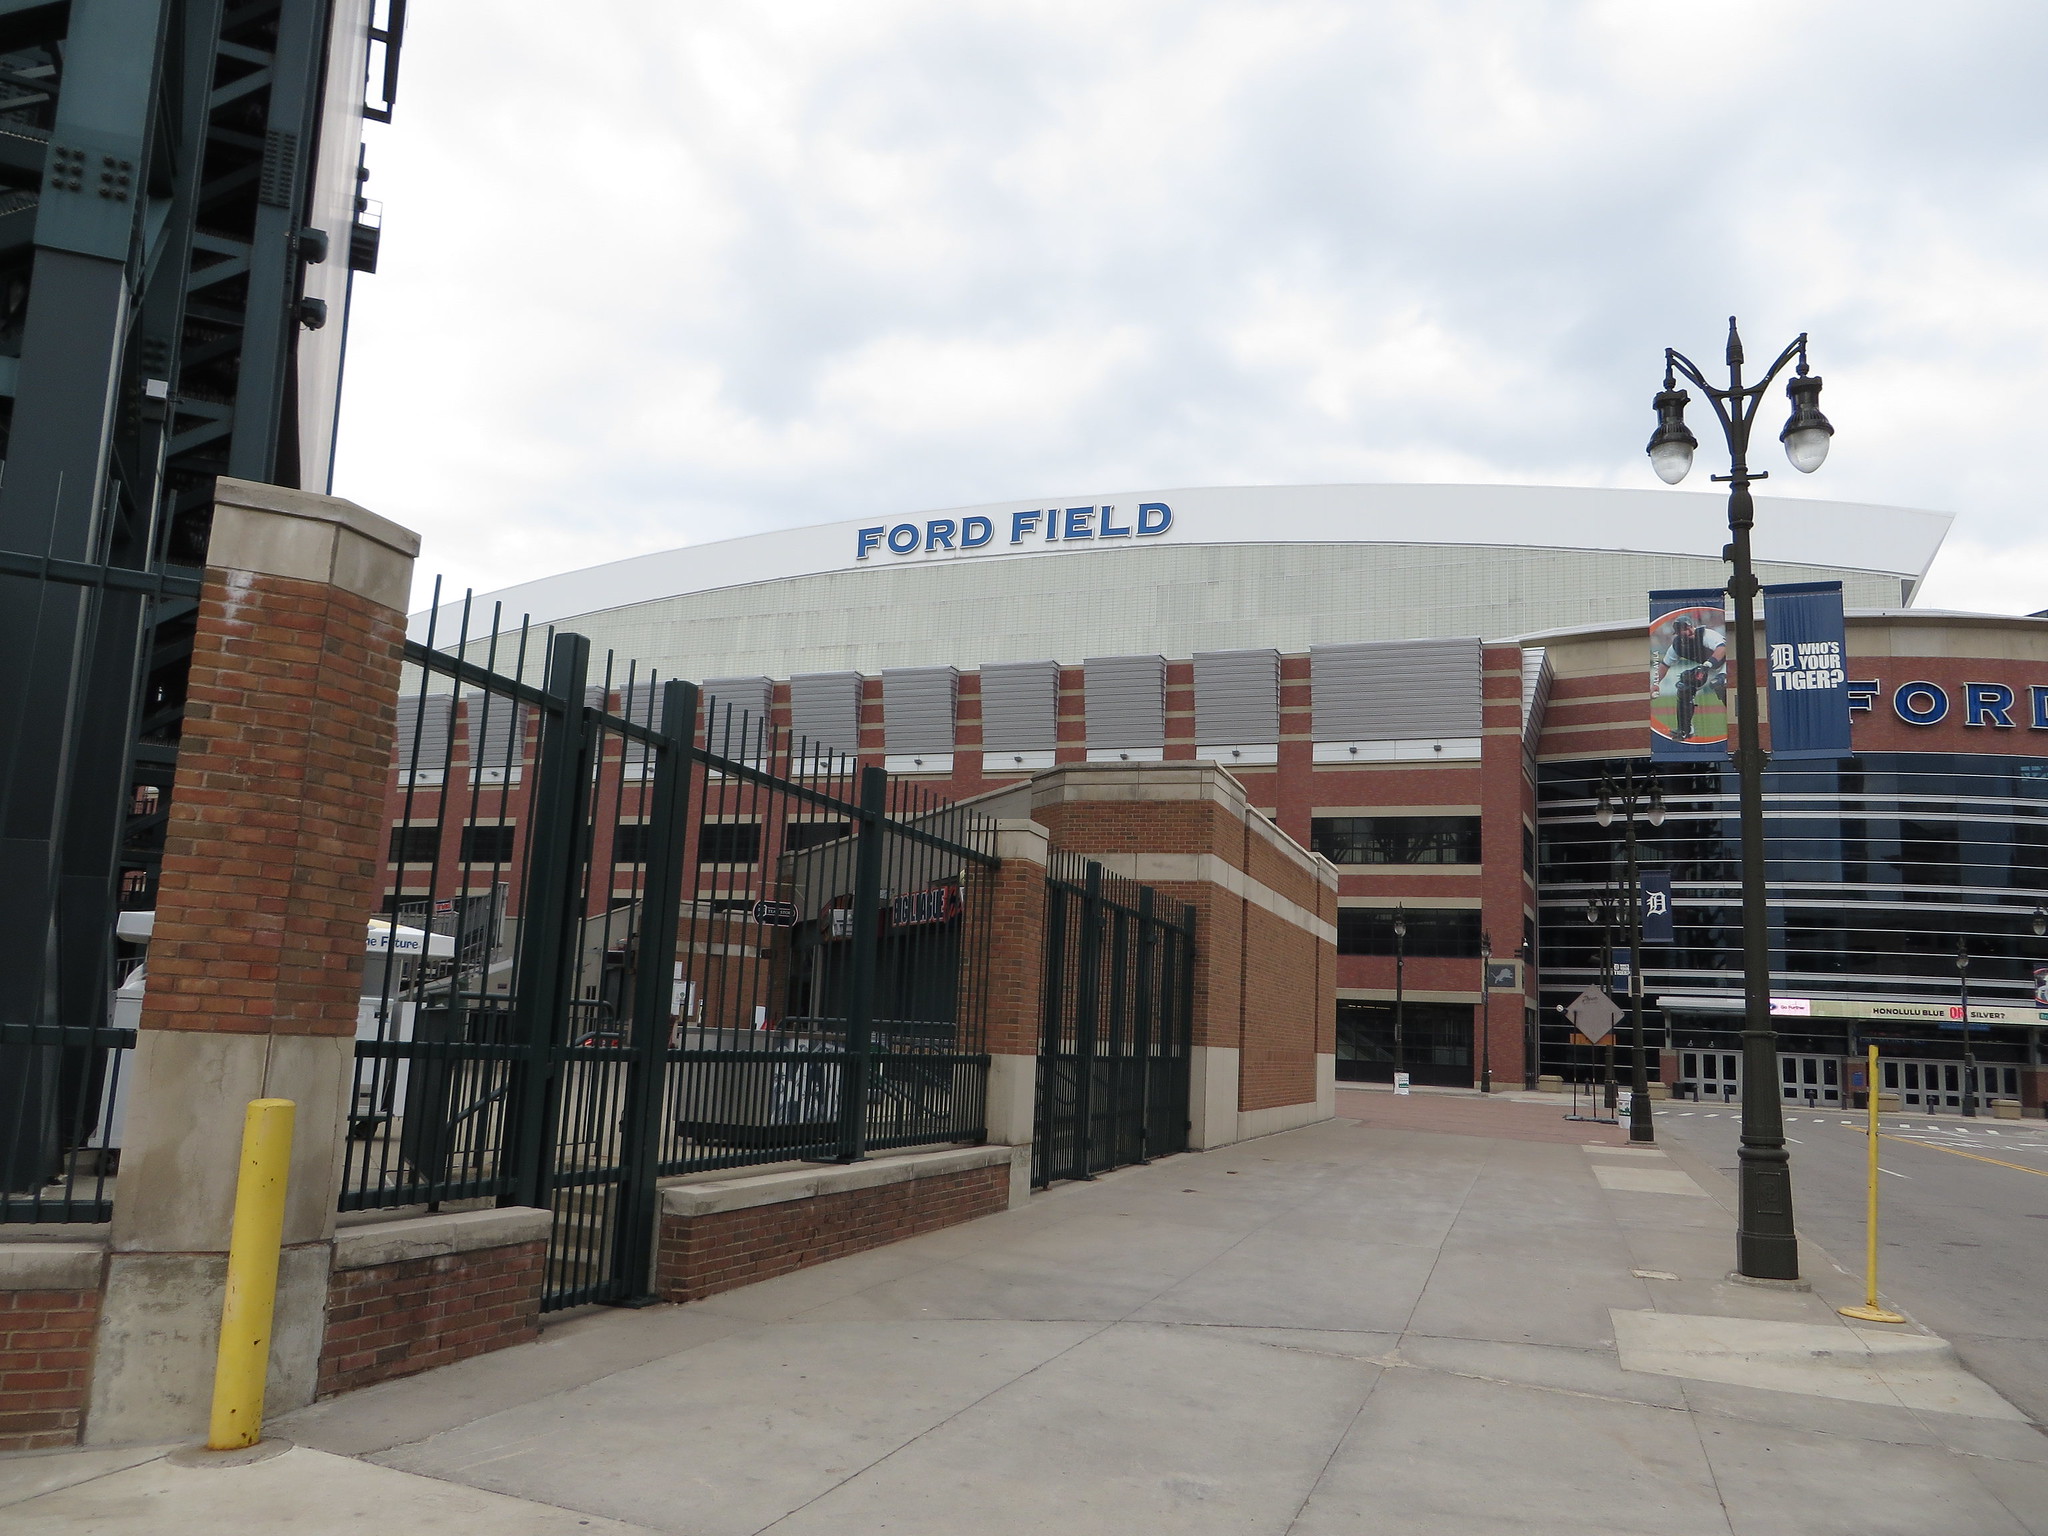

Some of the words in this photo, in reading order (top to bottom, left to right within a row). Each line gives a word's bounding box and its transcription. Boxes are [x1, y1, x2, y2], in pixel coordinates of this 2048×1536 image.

[856, 515, 994, 560] FORD
[1009, 502, 1174, 545] FIELD
[1797, 641, 1840, 655] WHO'S
[1798, 654, 1841, 670] YOUR
[1772, 669, 1845, 691] TIGER?
[381, 936, 419, 949] Fture
[1873, 1008, 1921, 1017] HONOLULU
[1922, 1009, 1945, 1017] BLUE
[1970, 1011, 2006, 1019] SILVER?
